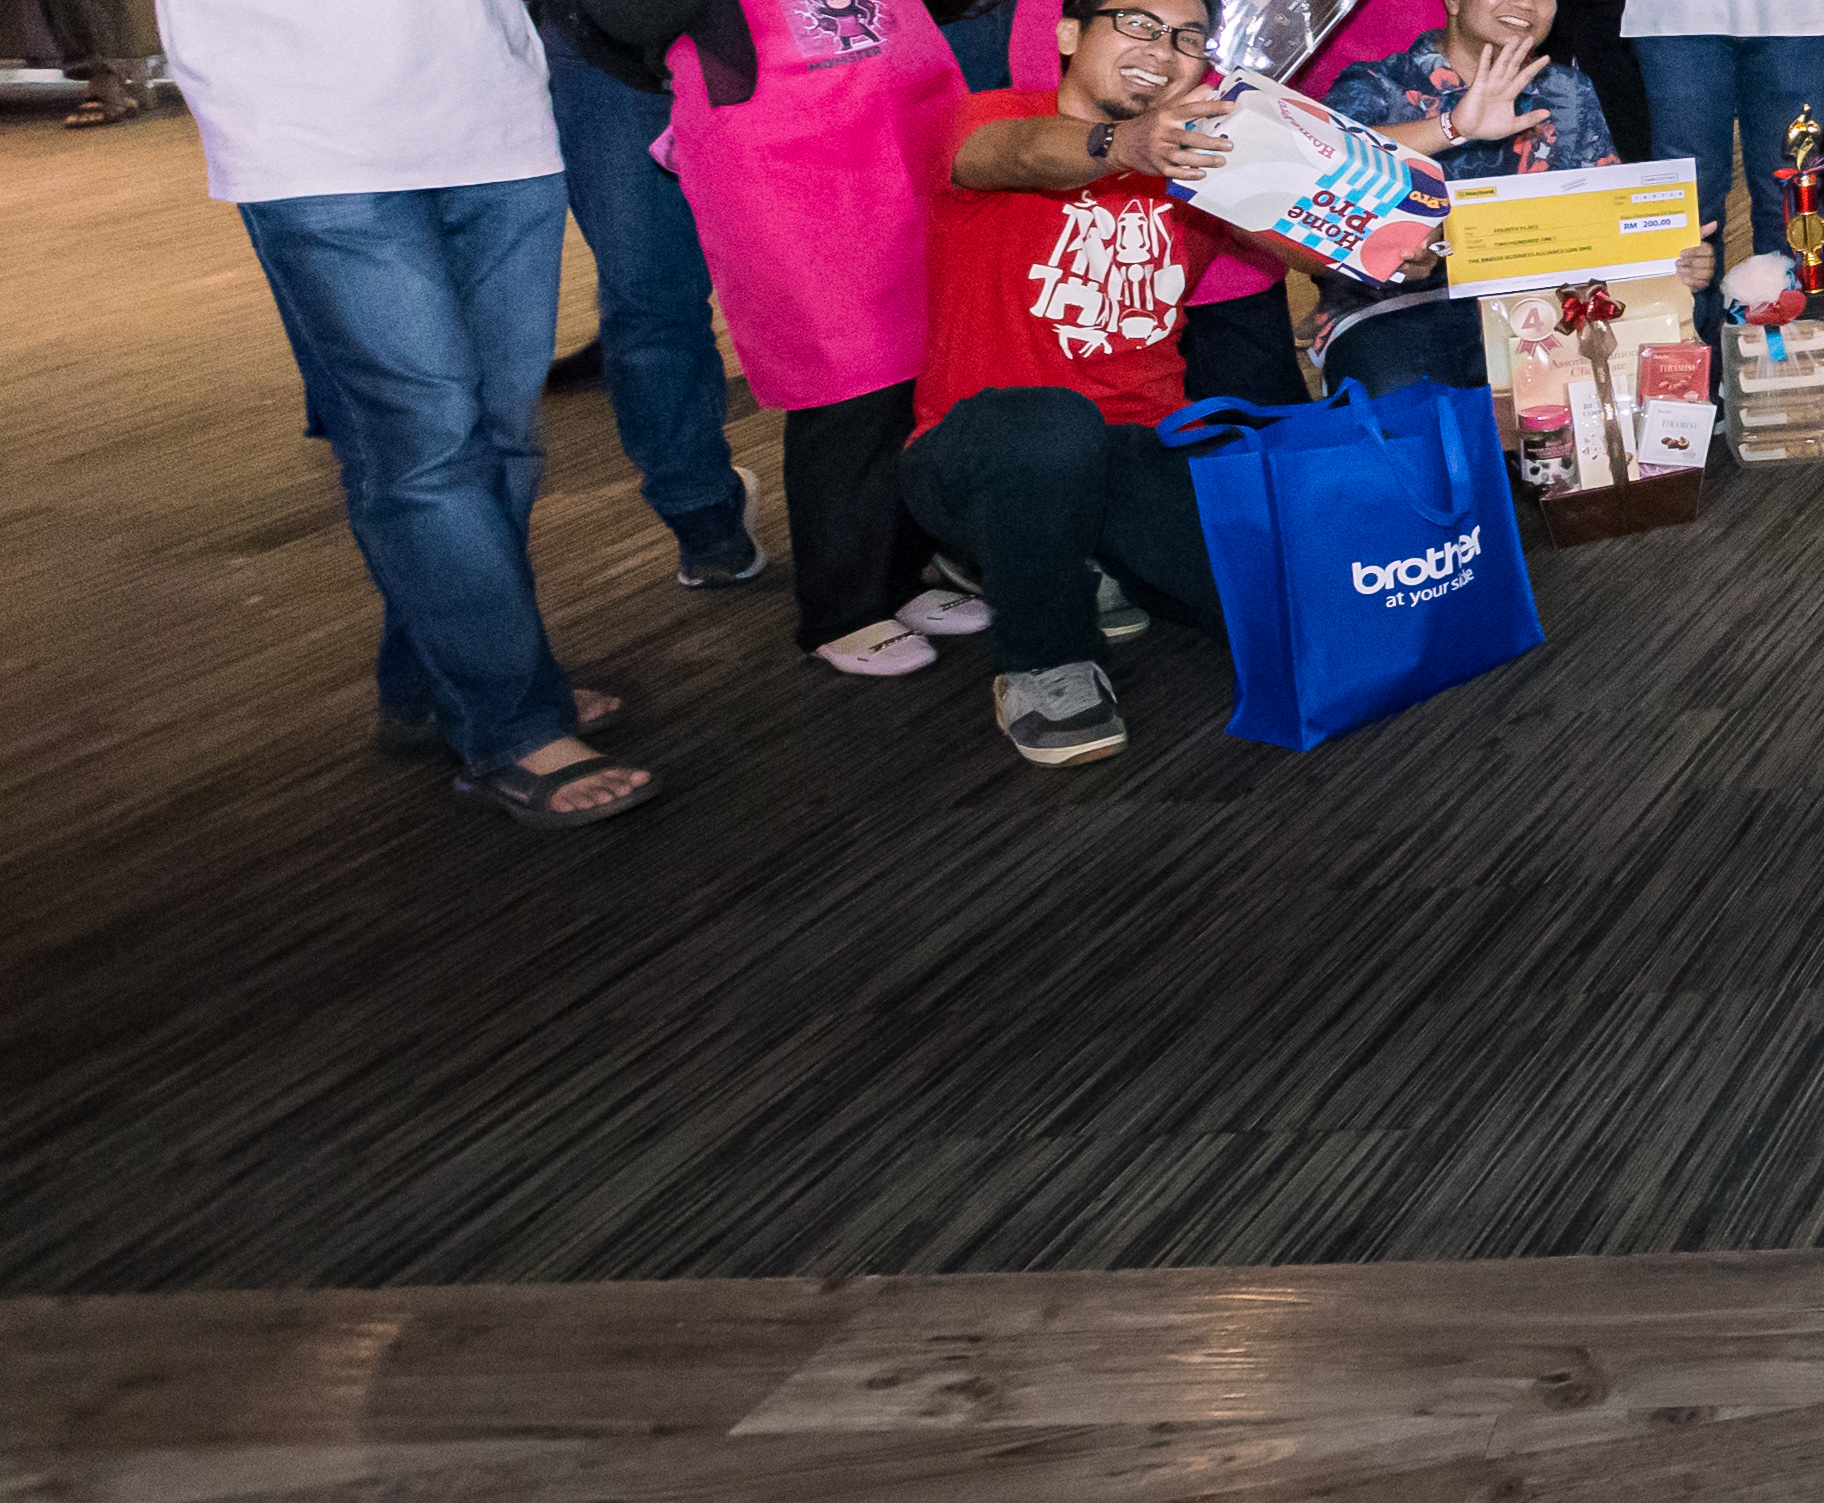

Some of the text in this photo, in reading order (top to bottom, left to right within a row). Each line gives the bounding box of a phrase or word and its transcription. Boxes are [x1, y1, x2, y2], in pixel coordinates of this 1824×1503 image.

[808, 45, 882, 71] MOMSTER
[1287, 206, 1364, 251] Home
[1312, 190, 1379, 234] Pro
[1624, 218, 1671, 230] RM 200.00
[1521, 307, 1543, 332] 4
[1551, 358, 1590, 370] Assorte
[1352, 525, 1482, 595] brother
[1385, 568, 1475, 608] at your side
